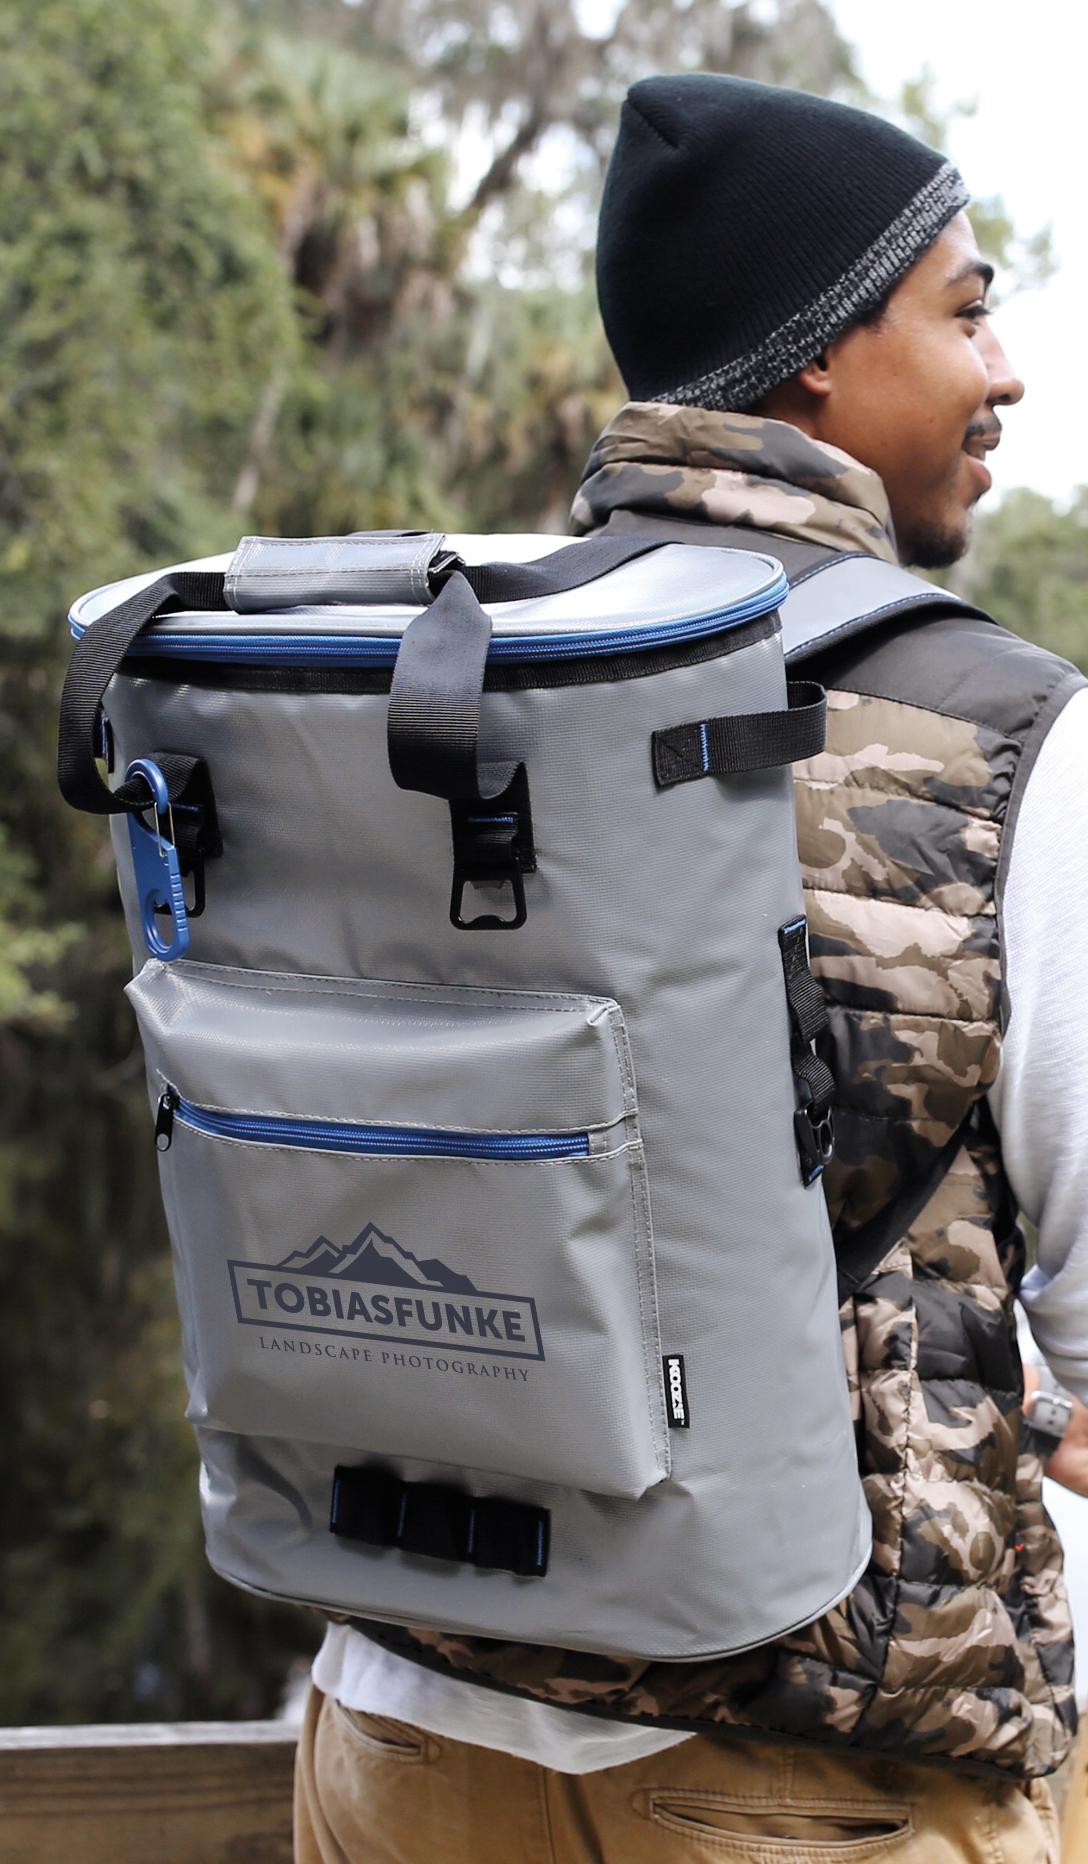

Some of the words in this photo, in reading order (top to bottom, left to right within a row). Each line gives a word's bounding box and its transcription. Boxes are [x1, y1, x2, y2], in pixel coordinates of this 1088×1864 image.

[246, 1278, 526, 1342] TOBIASFUNKE
[259, 1336, 373, 1362] LANDSCAPE
[381, 1352, 530, 1382] PHOTOGRAPHY
